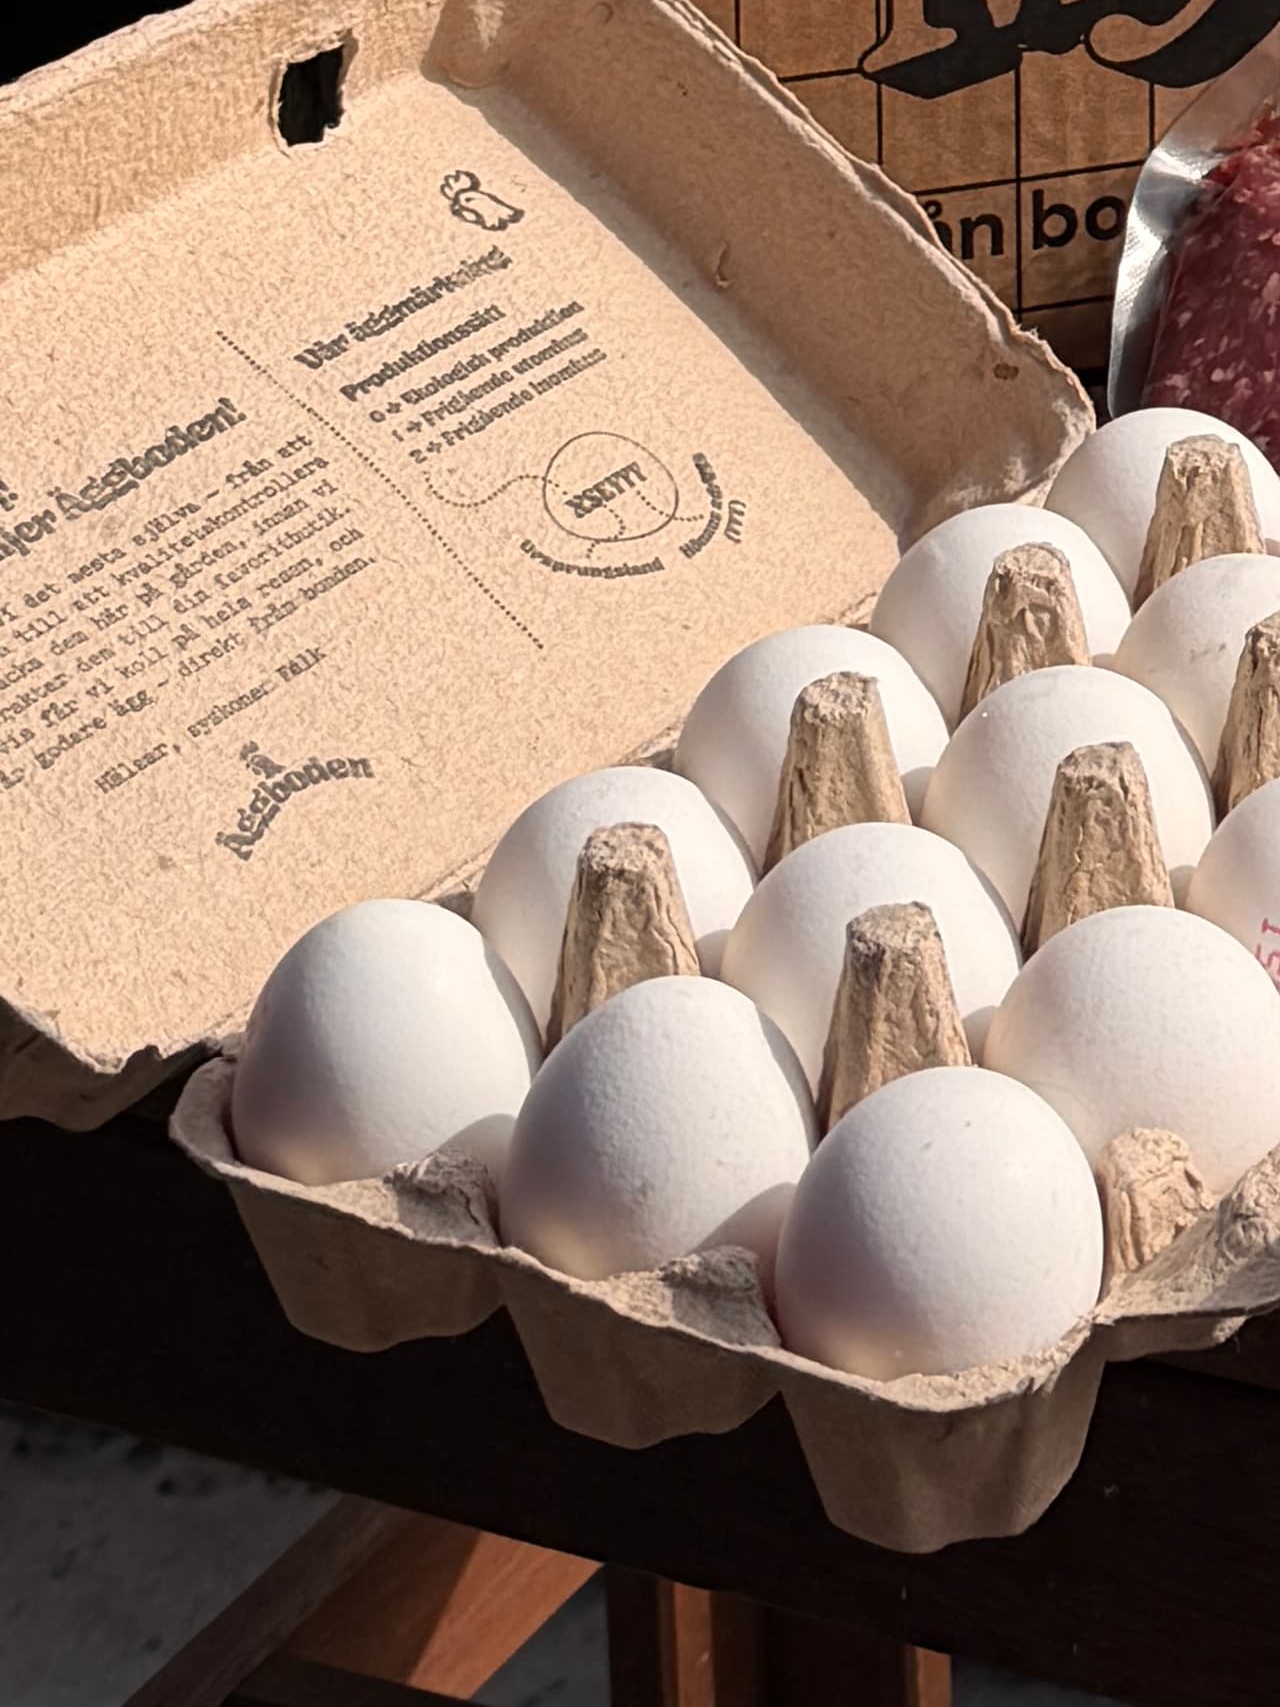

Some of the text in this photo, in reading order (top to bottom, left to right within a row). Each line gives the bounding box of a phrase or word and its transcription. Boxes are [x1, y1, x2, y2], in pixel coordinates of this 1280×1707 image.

[1032, 188, 1127, 250] bo
[339, 303, 508, 403] Produktionssätt
[47, 396, 248, 523] Äggboden!
[23, 582, 62, 609] det
[519, 538, 666, 580] Ursprungsland
[214, 754, 375, 862] Äggboden
